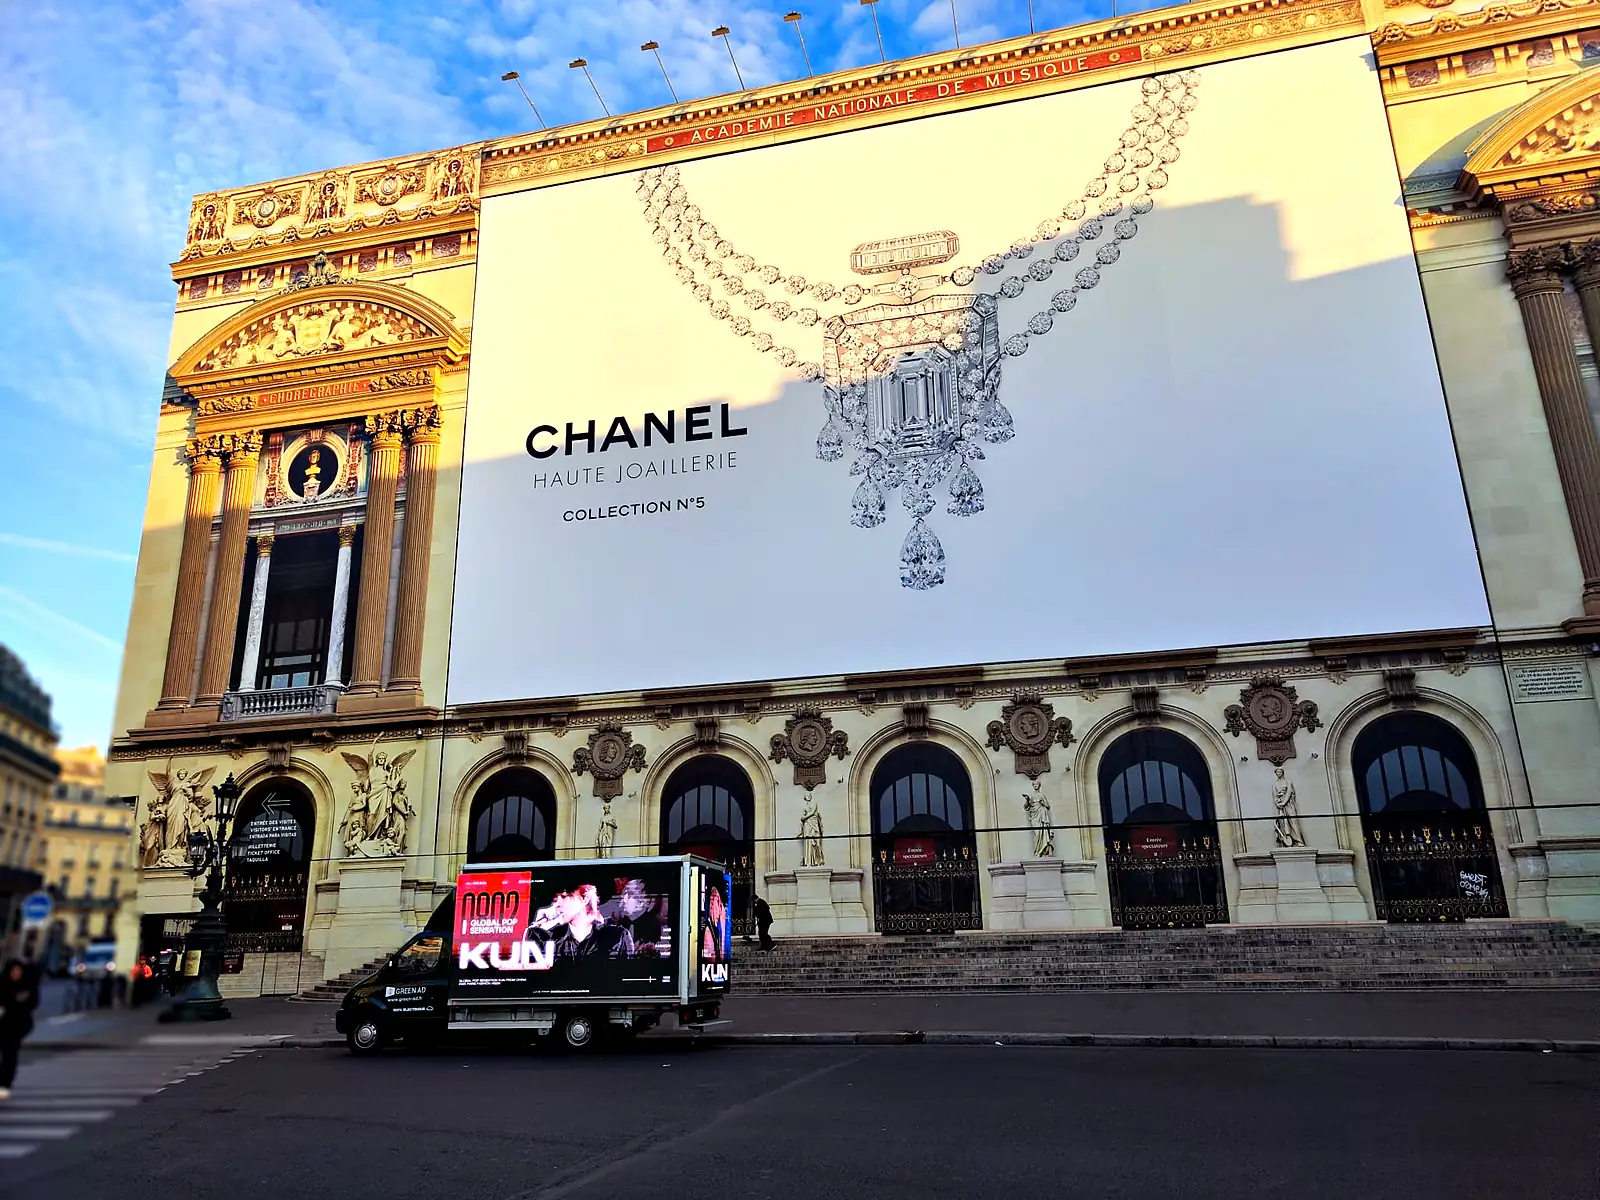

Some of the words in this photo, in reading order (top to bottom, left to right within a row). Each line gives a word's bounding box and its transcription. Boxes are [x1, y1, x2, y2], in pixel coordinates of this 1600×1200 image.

[691, 112, 795, 143] ACADEMIE
[814, 90, 917, 121] NATIONALE
[937, 80, 965, 97] DE
[986, 56, 1089, 88] MUSIQUE
[269, 382, 360, 404] CHOREGRAPHIE
[525, 402, 748, 459] CHANEL
[533, 466, 605, 489] HAUTE
[616, 451, 737, 484] JOAILLERIE
[562, 500, 672, 522] COLLECTION
[677, 496, 706, 511] N°5
[470, 919, 500, 927] GLOBAL
[502, 918, 518, 926] POP
[470, 926, 514, 935] SENSATION
[459, 941, 555, 970] KUN
[702, 964, 728, 982] KUN
